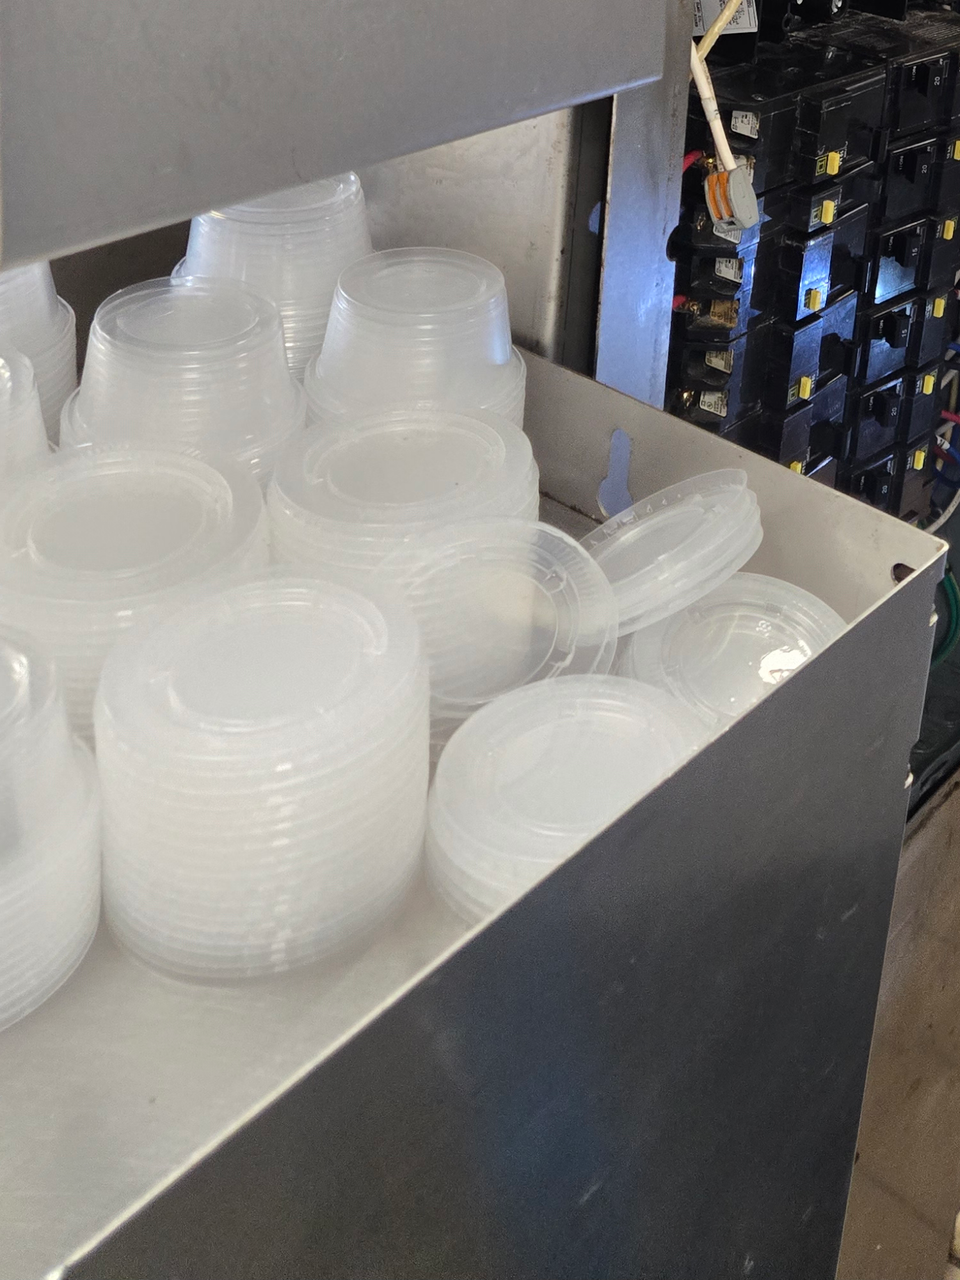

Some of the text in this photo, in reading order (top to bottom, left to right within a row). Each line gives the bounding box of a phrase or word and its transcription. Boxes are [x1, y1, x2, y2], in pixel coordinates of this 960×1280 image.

[933, 76, 941, 86] 20
[921, 164, 928, 174] 20
[911, 247, 918, 257] 15
[901, 328, 908, 338] 15
[891, 406, 898, 416] 20
[881, 484, 888, 495] 20
